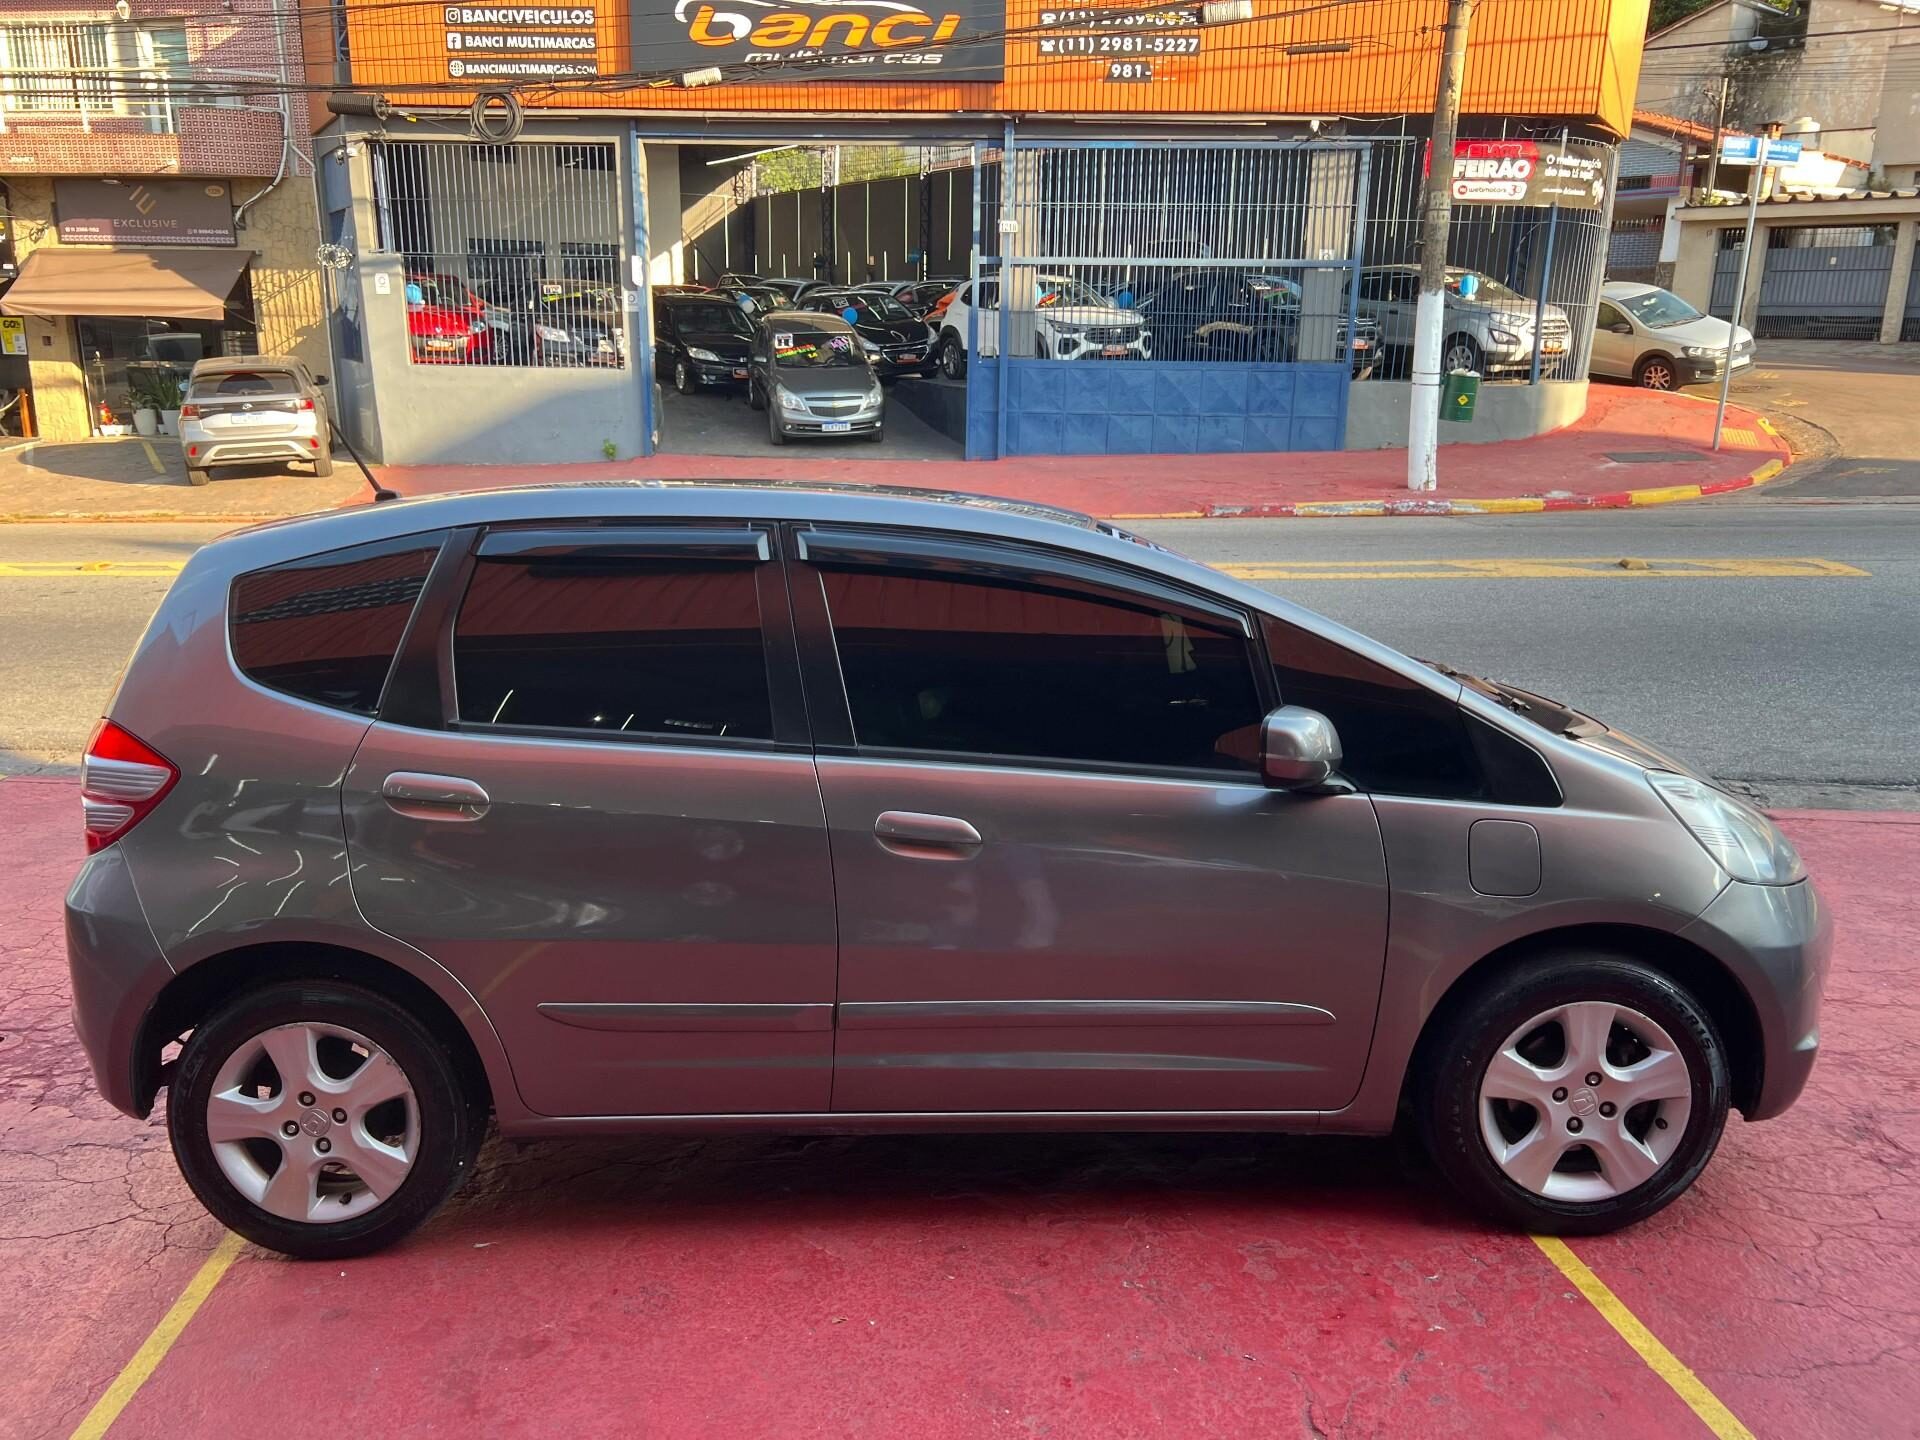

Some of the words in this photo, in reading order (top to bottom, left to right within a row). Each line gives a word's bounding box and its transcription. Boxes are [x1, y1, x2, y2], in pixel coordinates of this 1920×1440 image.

[462, 9, 595, 25] BANCIVEICULOS
[688, 5, 960, 48] banci
[465, 35, 504, 48] BANCI
[506, 36, 596, 49] MULTIMARCAS
[1059, 37, 1095, 53] (11)
[1100, 37, 1199, 52] 2981-5227
[465, 64, 597, 75] BANCIMULTIMARCAS.COM
[1470, 145, 1520, 158] BLACK
[1453, 157, 1531, 178] FEIRÃO
[113, 219, 177, 229] EXCLUSIVE
